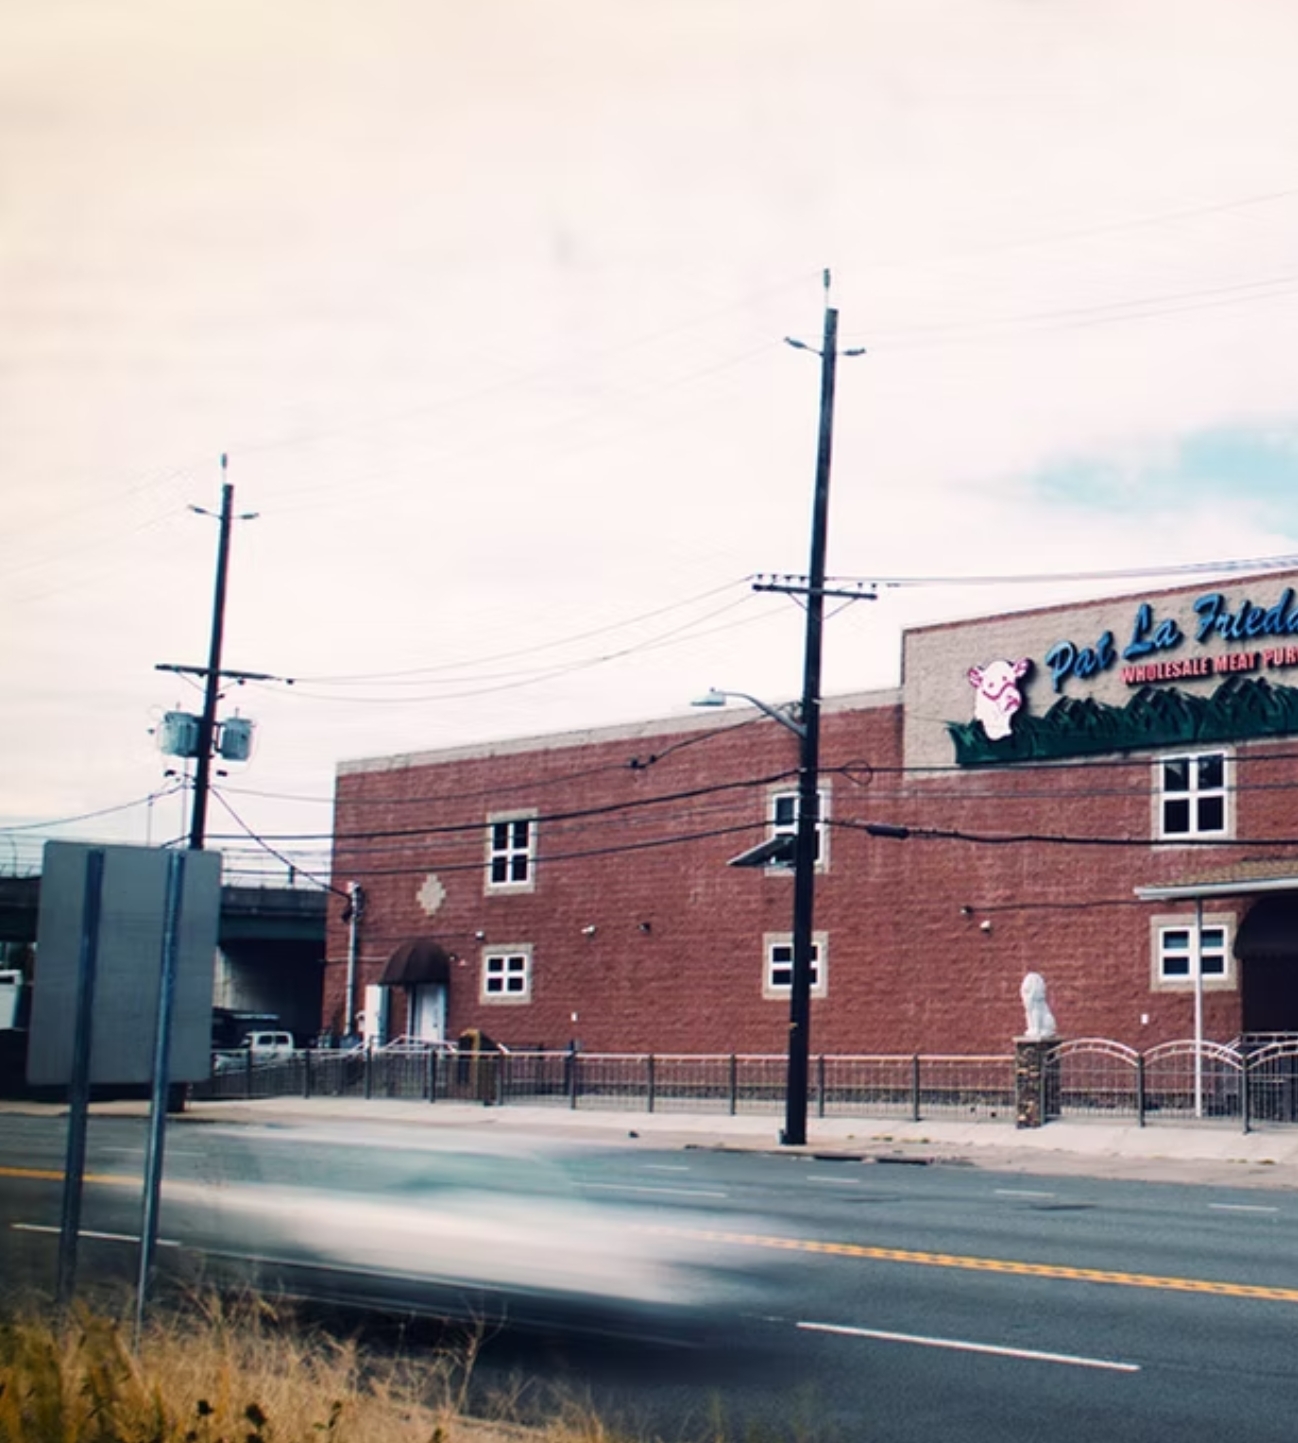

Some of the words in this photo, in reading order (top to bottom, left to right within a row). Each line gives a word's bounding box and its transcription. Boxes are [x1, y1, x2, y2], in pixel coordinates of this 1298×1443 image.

[1045, 630, 1116, 693] Pat
[1122, 603, 1183, 662] La
[1120, 656, 1211, 685] WHOLESALE
[1213, 652, 1260, 677] MEAT
